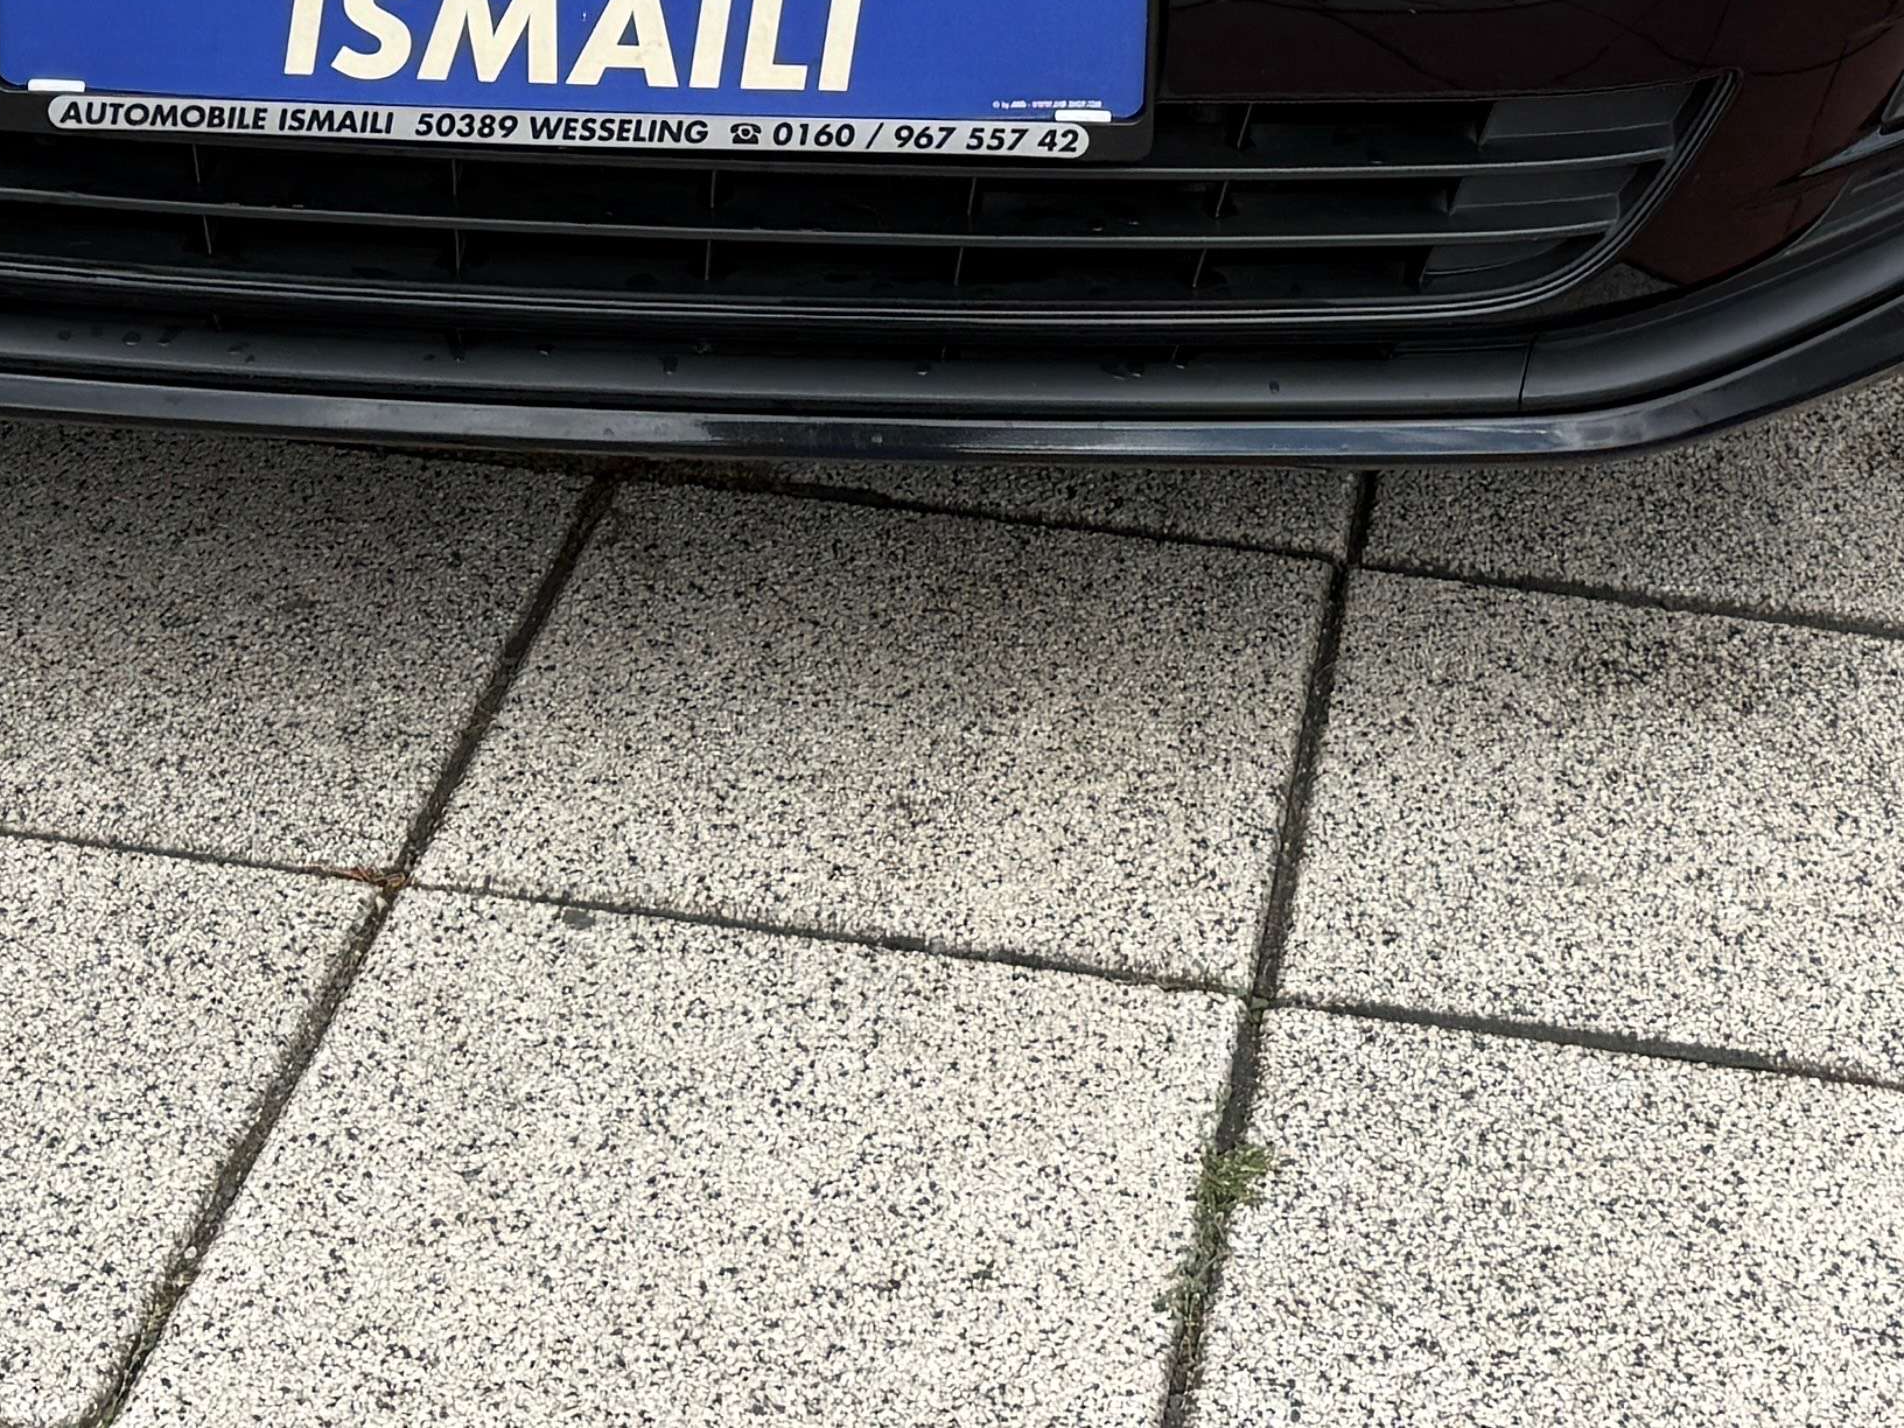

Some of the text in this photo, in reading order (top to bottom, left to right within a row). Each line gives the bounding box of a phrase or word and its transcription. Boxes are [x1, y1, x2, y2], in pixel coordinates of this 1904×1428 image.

[59, 101, 268, 131] AUTOMOBILE
[277, 108, 395, 135] ISMAILI
[414, 112, 519, 139] 50389
[529, 116, 709, 144] WESSELING
[772, 121, 855, 148] 0160
[894, 125, 957, 150] 967
[965, 127, 1029, 151] 557
[1037, 128, 1079, 153] 42
